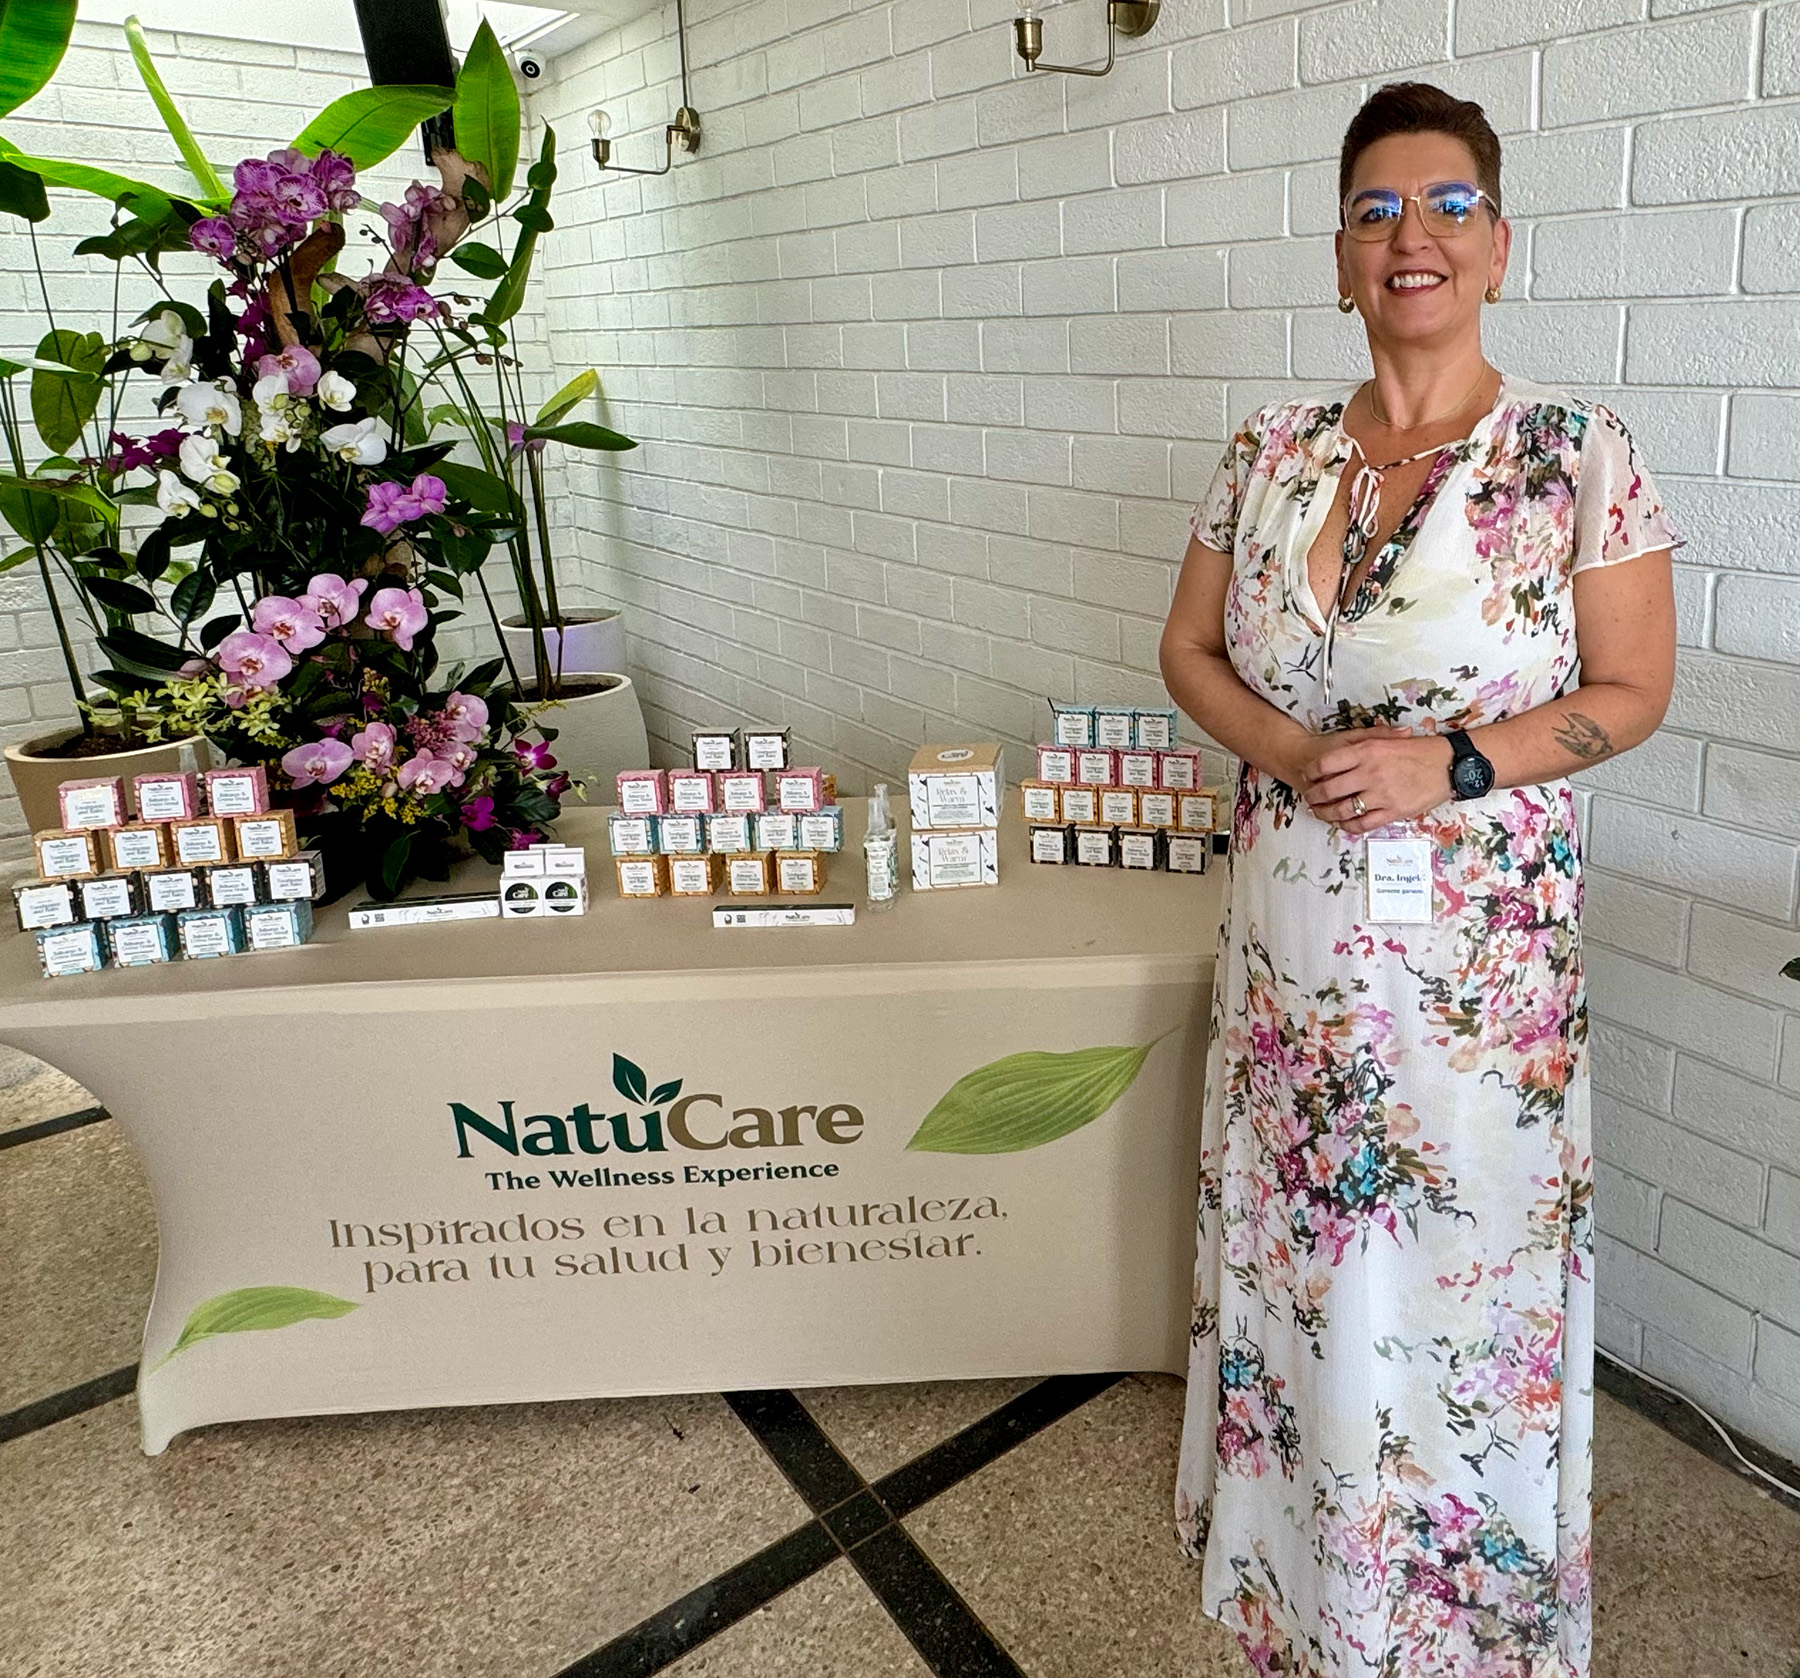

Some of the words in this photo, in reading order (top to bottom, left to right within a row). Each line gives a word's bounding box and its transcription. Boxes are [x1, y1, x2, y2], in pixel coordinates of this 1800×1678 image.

[447, 1093, 864, 1158] NatuCare
[485, 1171, 541, 1190] The
[548, 1167, 675, 1189] Wellness
[683, 1161, 840, 1187] Experience
[328, 1213, 585, 1254] Inspirados
[603, 1213, 666, 1238] en
[686, 1206, 727, 1235] la
[747, 1195, 1008, 1232] naturaleza,
[363, 1258, 470, 1294] para
[489, 1252, 536, 1280] tu
[554, 1243, 689, 1277] salud
[707, 1246, 732, 1277] y
[752, 1228, 982, 1269] bienestar.
